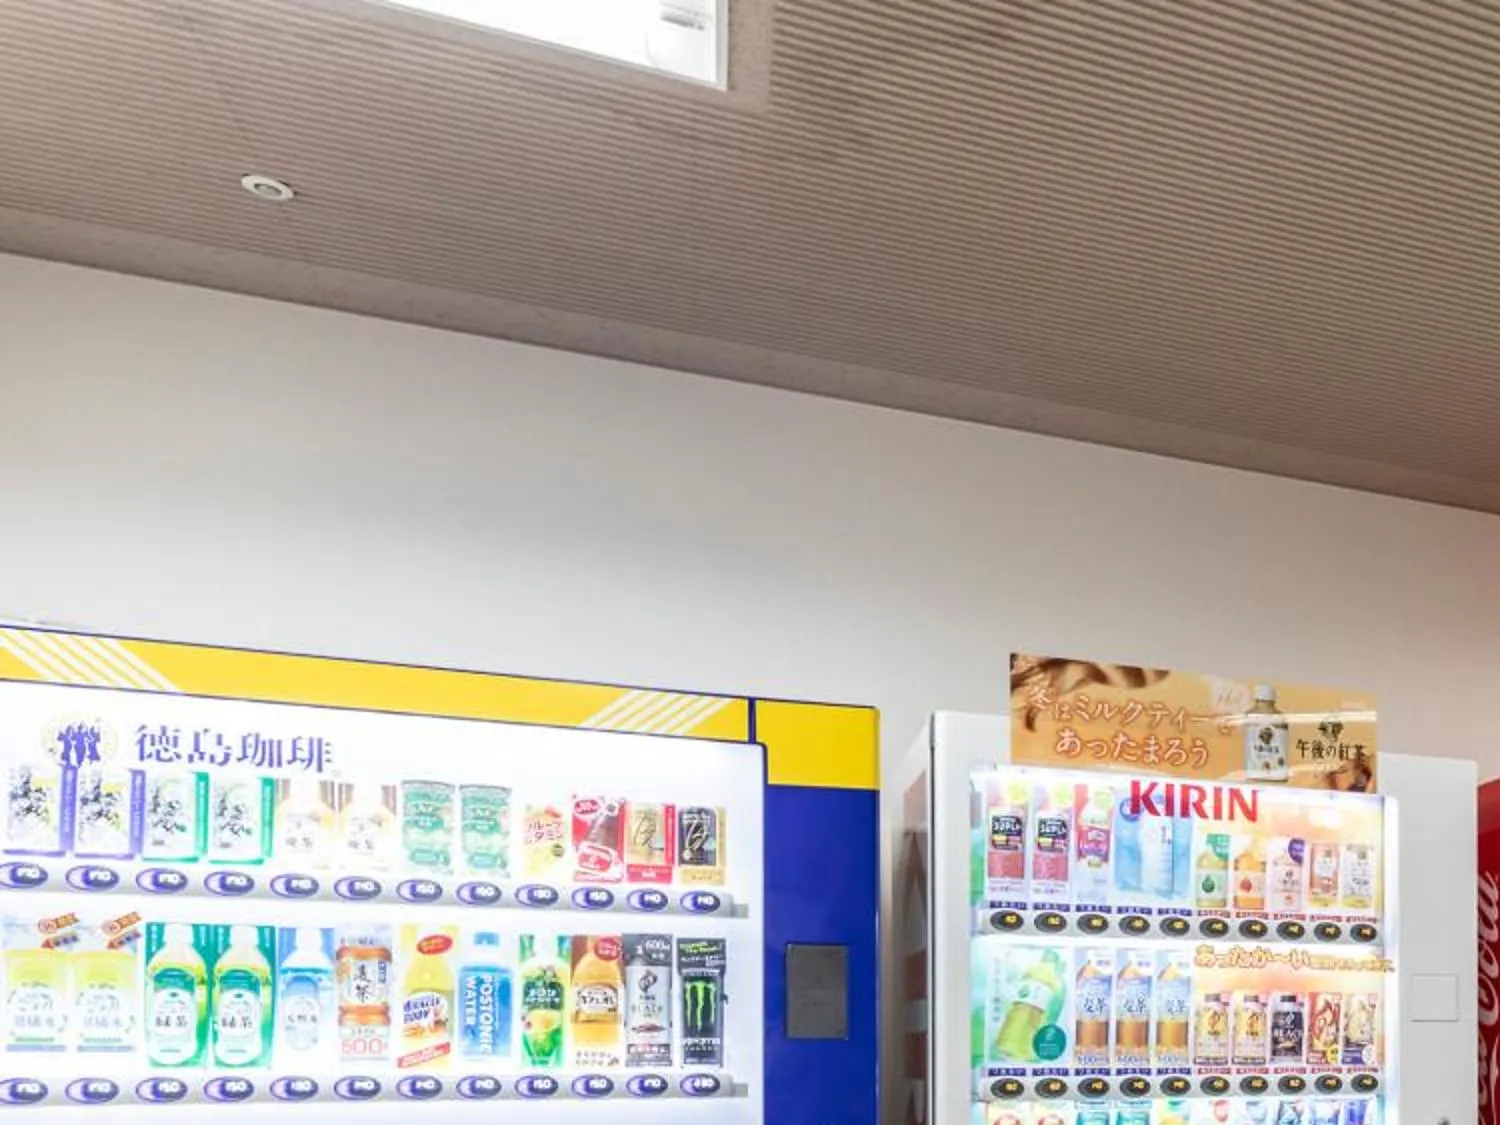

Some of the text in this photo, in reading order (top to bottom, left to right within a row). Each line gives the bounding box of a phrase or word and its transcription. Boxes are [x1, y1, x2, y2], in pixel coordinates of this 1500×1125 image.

[136, 724, 334, 773] 徳島珈琲
[1056, 727, 1210, 769] あったまろう
[1296, 738, 1366, 763] 午後の紅茶
[1130, 779, 1259, 824] KIRIN
